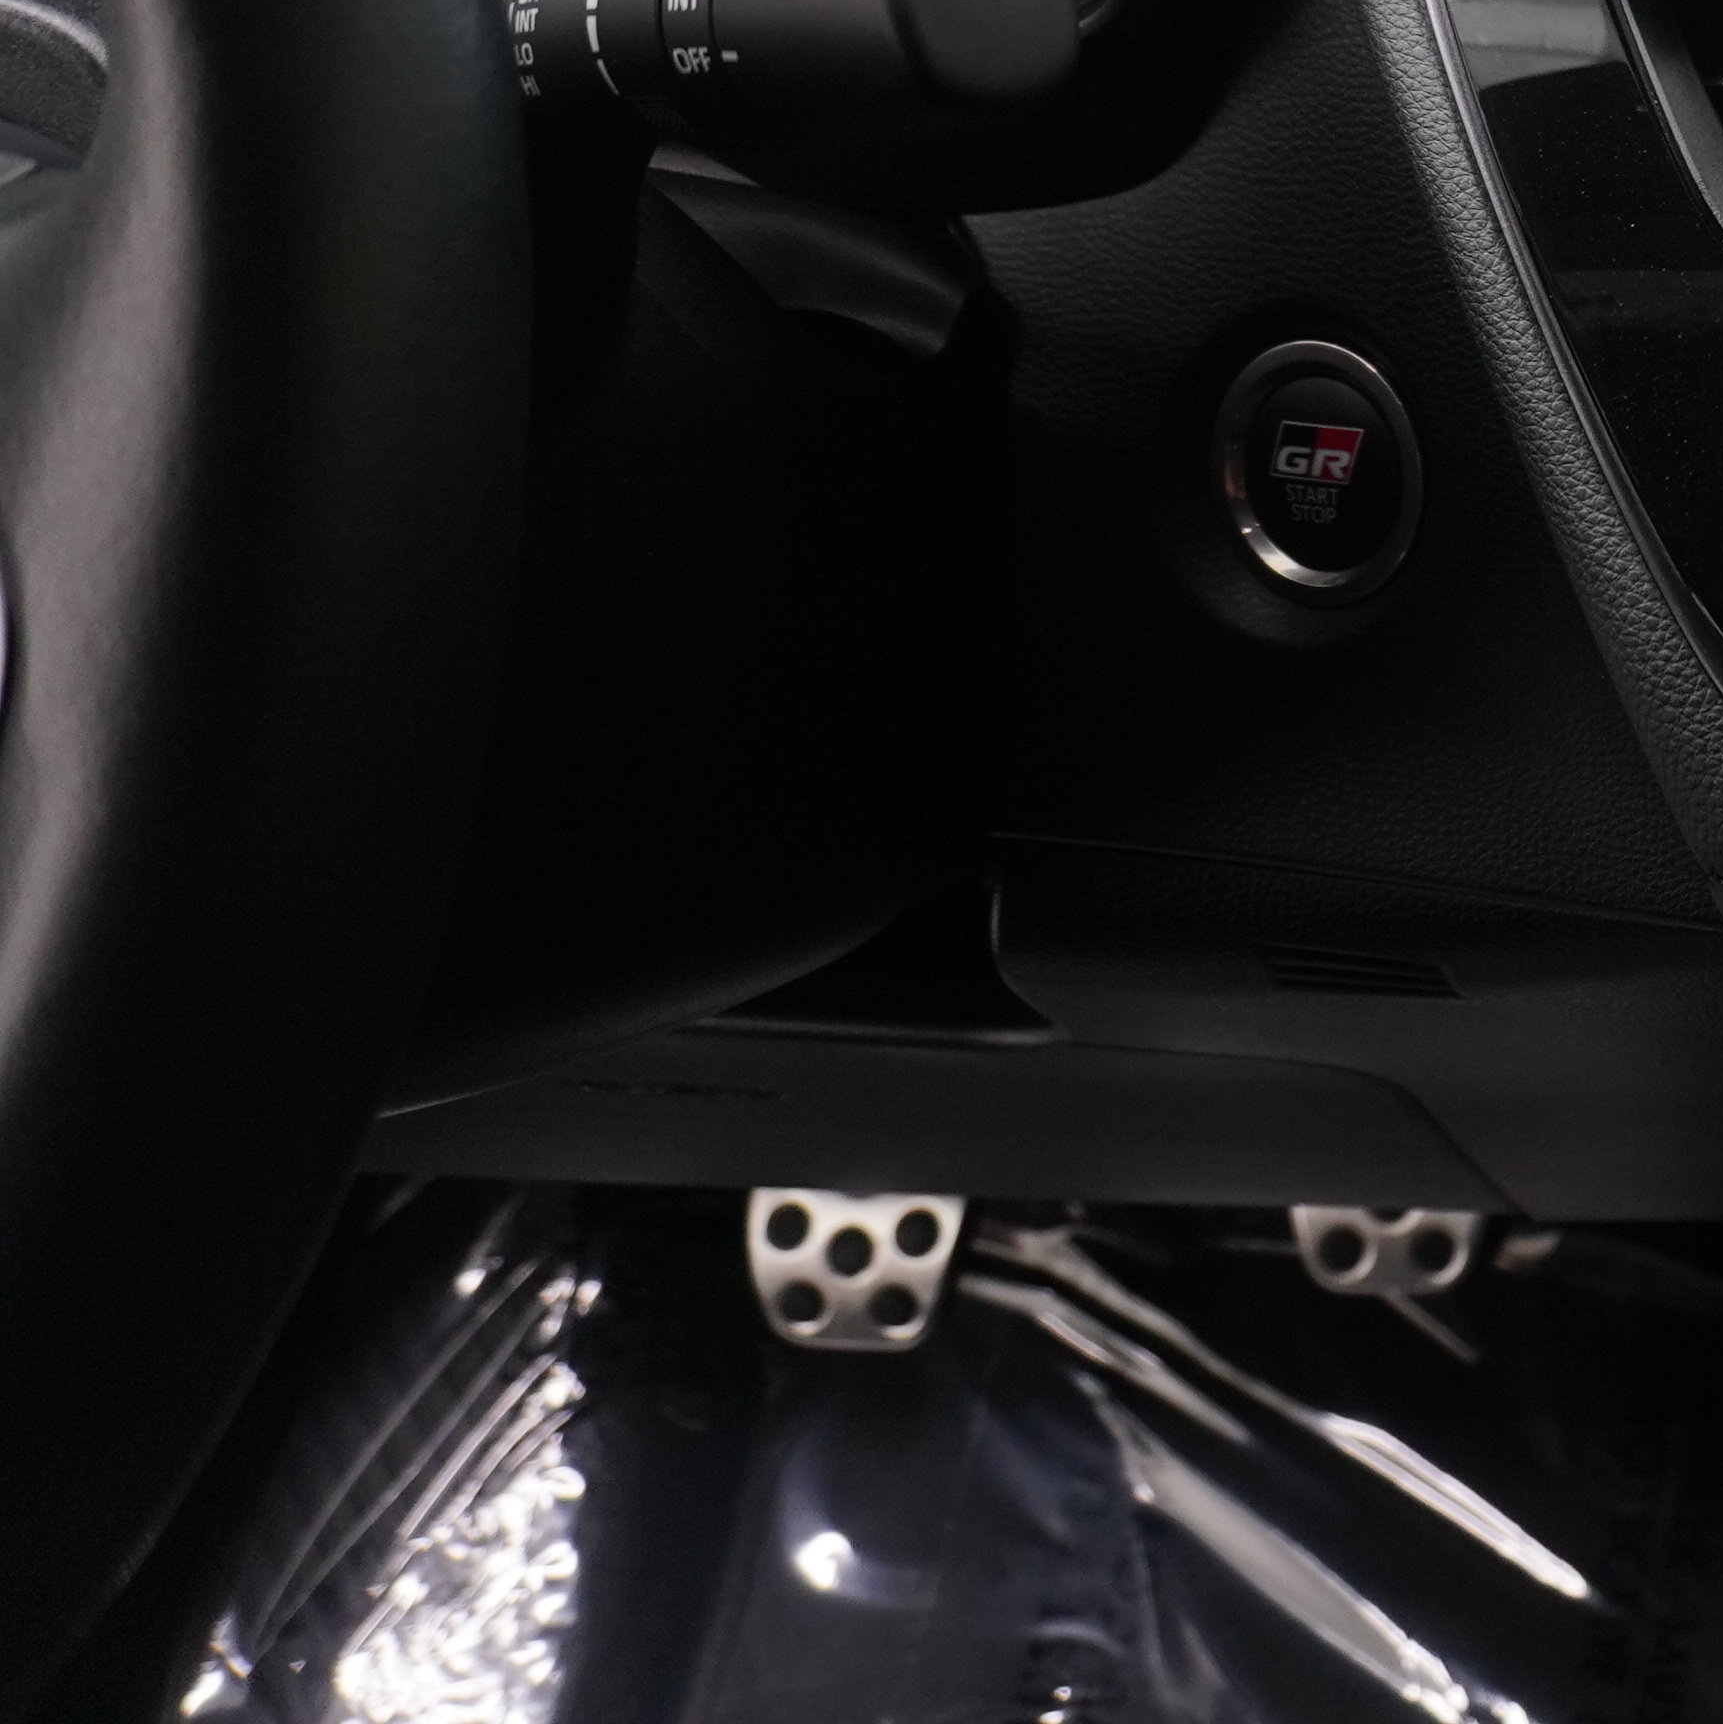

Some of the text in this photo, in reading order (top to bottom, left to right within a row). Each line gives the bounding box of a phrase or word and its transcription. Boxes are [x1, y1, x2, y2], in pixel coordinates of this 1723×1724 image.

[515, 8, 539, 34] INT
[514, 42, 534, 66] LO
[672, 46, 711, 74] OFF
[1275, 445, 1351, 480] GR
[1286, 484, 1340, 506] START
[1292, 505, 1337, 524] STOP
